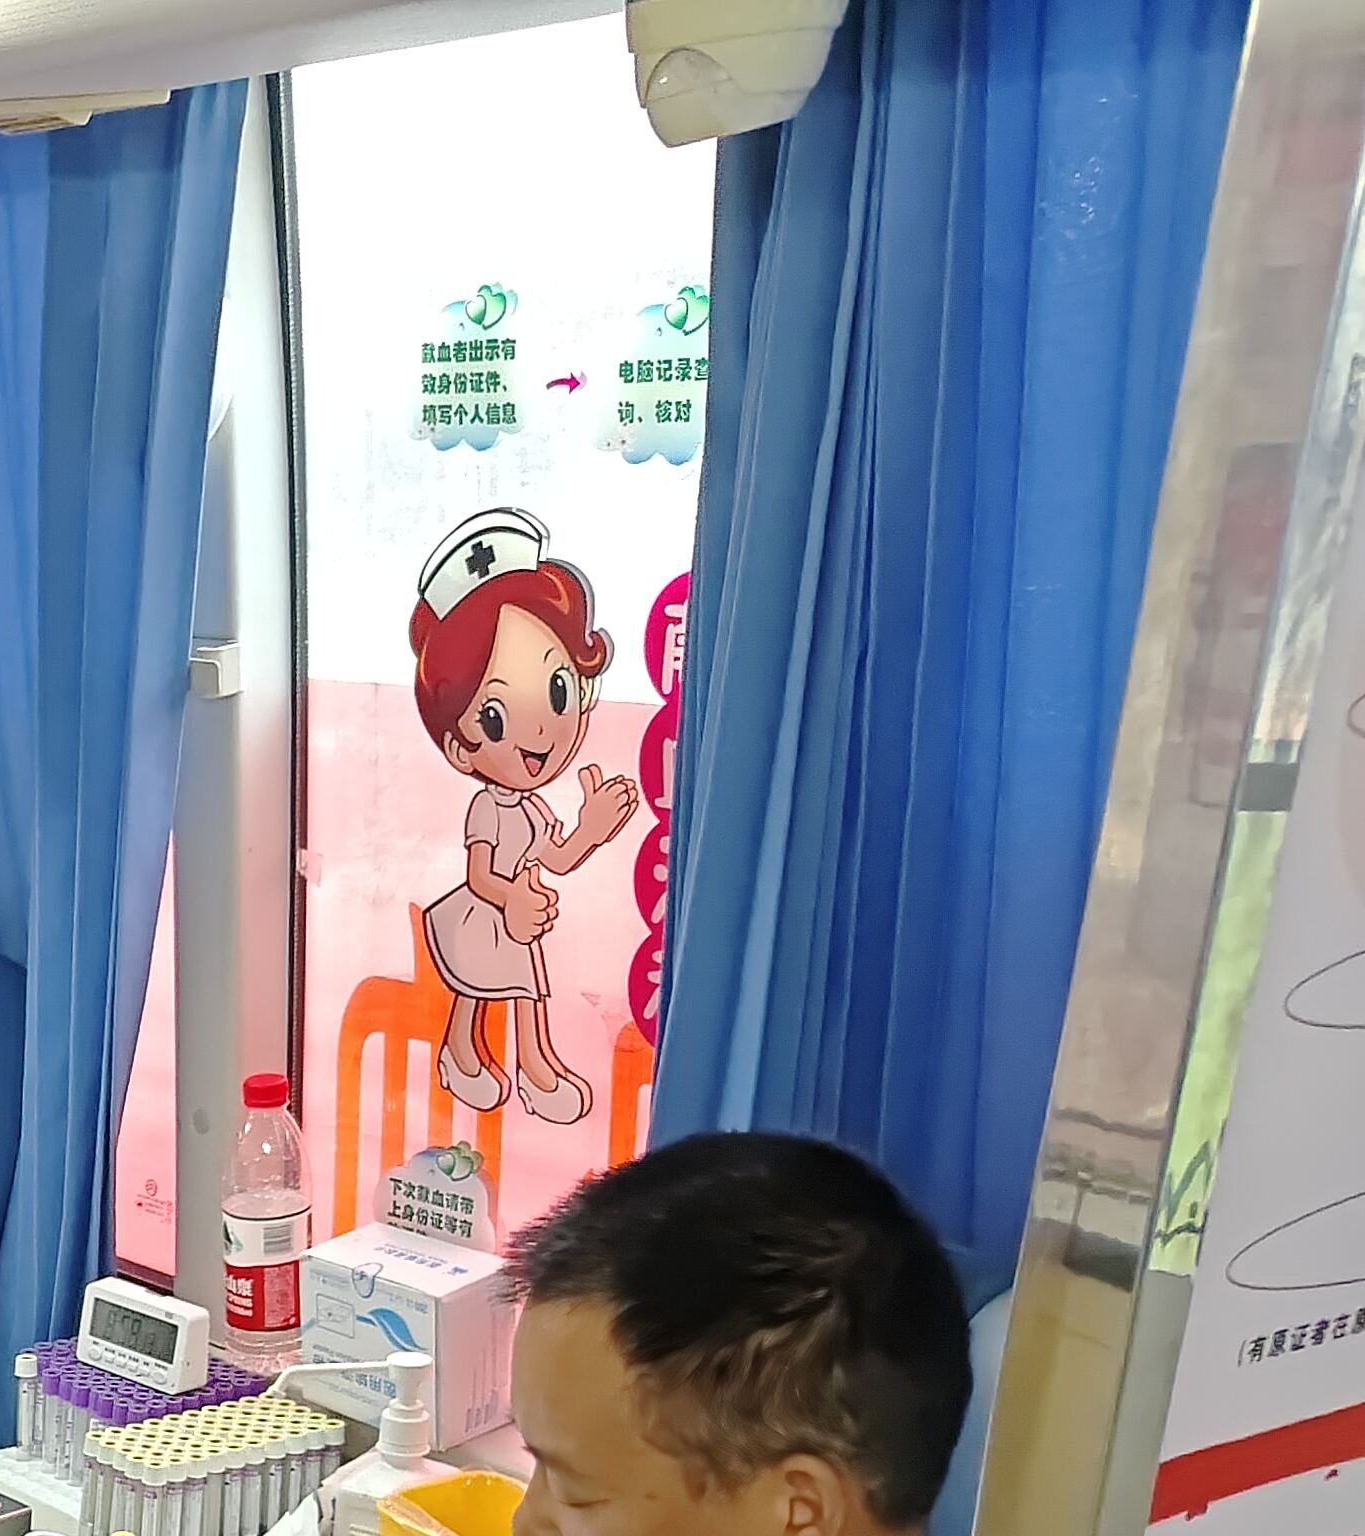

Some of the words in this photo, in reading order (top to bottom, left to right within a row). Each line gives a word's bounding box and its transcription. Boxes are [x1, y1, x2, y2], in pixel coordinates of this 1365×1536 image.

[421, 338, 516, 364] 献血者出示有
[619, 357, 709, 384] 电脑记录查
[422, 402, 517, 426] 填写个人信息
[618, 400, 692, 424] 询、核对
[389, 1177, 474, 1215] 下次献血请带
[388, 1200, 473, 1238] 上身份证等有
